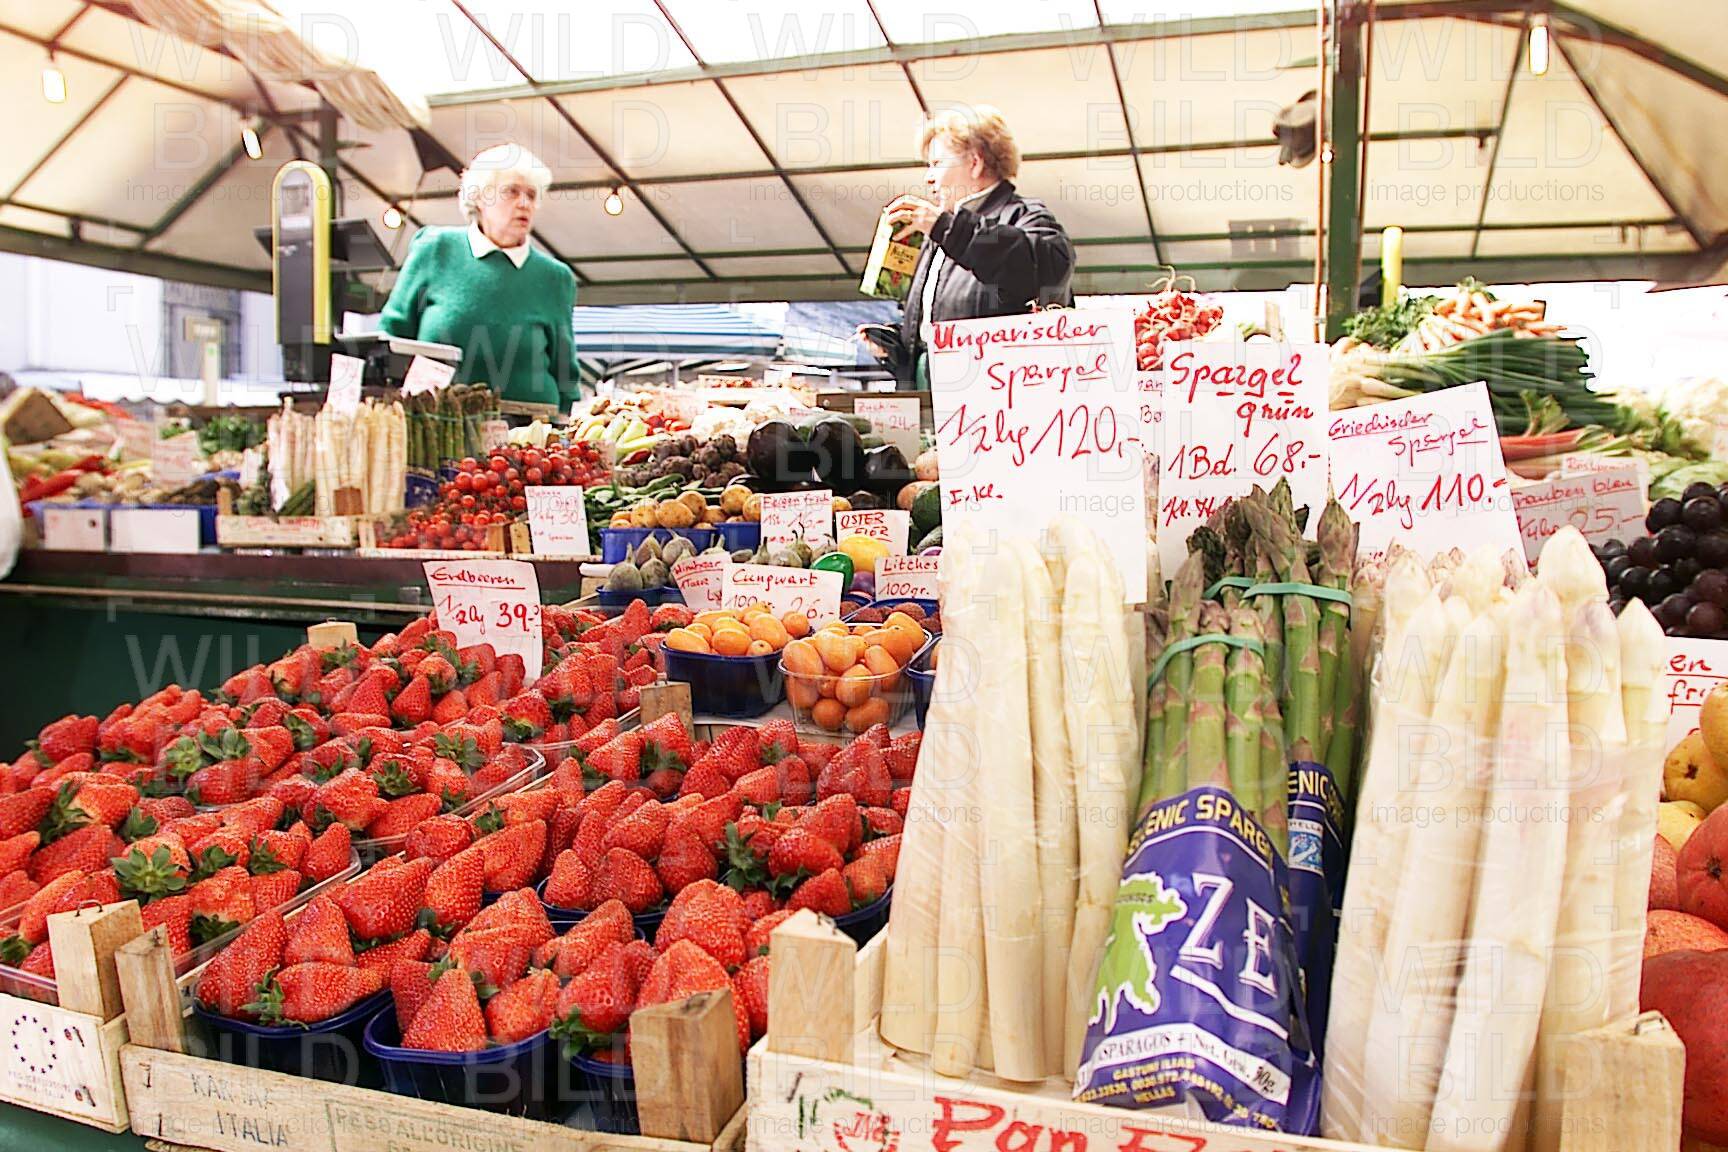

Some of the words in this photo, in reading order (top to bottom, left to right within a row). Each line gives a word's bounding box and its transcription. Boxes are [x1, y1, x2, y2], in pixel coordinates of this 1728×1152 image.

[934, 316, 1108, 360] Ungarischer
[987, 353, 1108, 409] Spargel
[1170, 353, 1303, 404] Spargel
[1236, 399, 1315, 438] grün
[840, 511, 884, 529] OSTER
[216, 1109, 289, 1147] ITALIA
